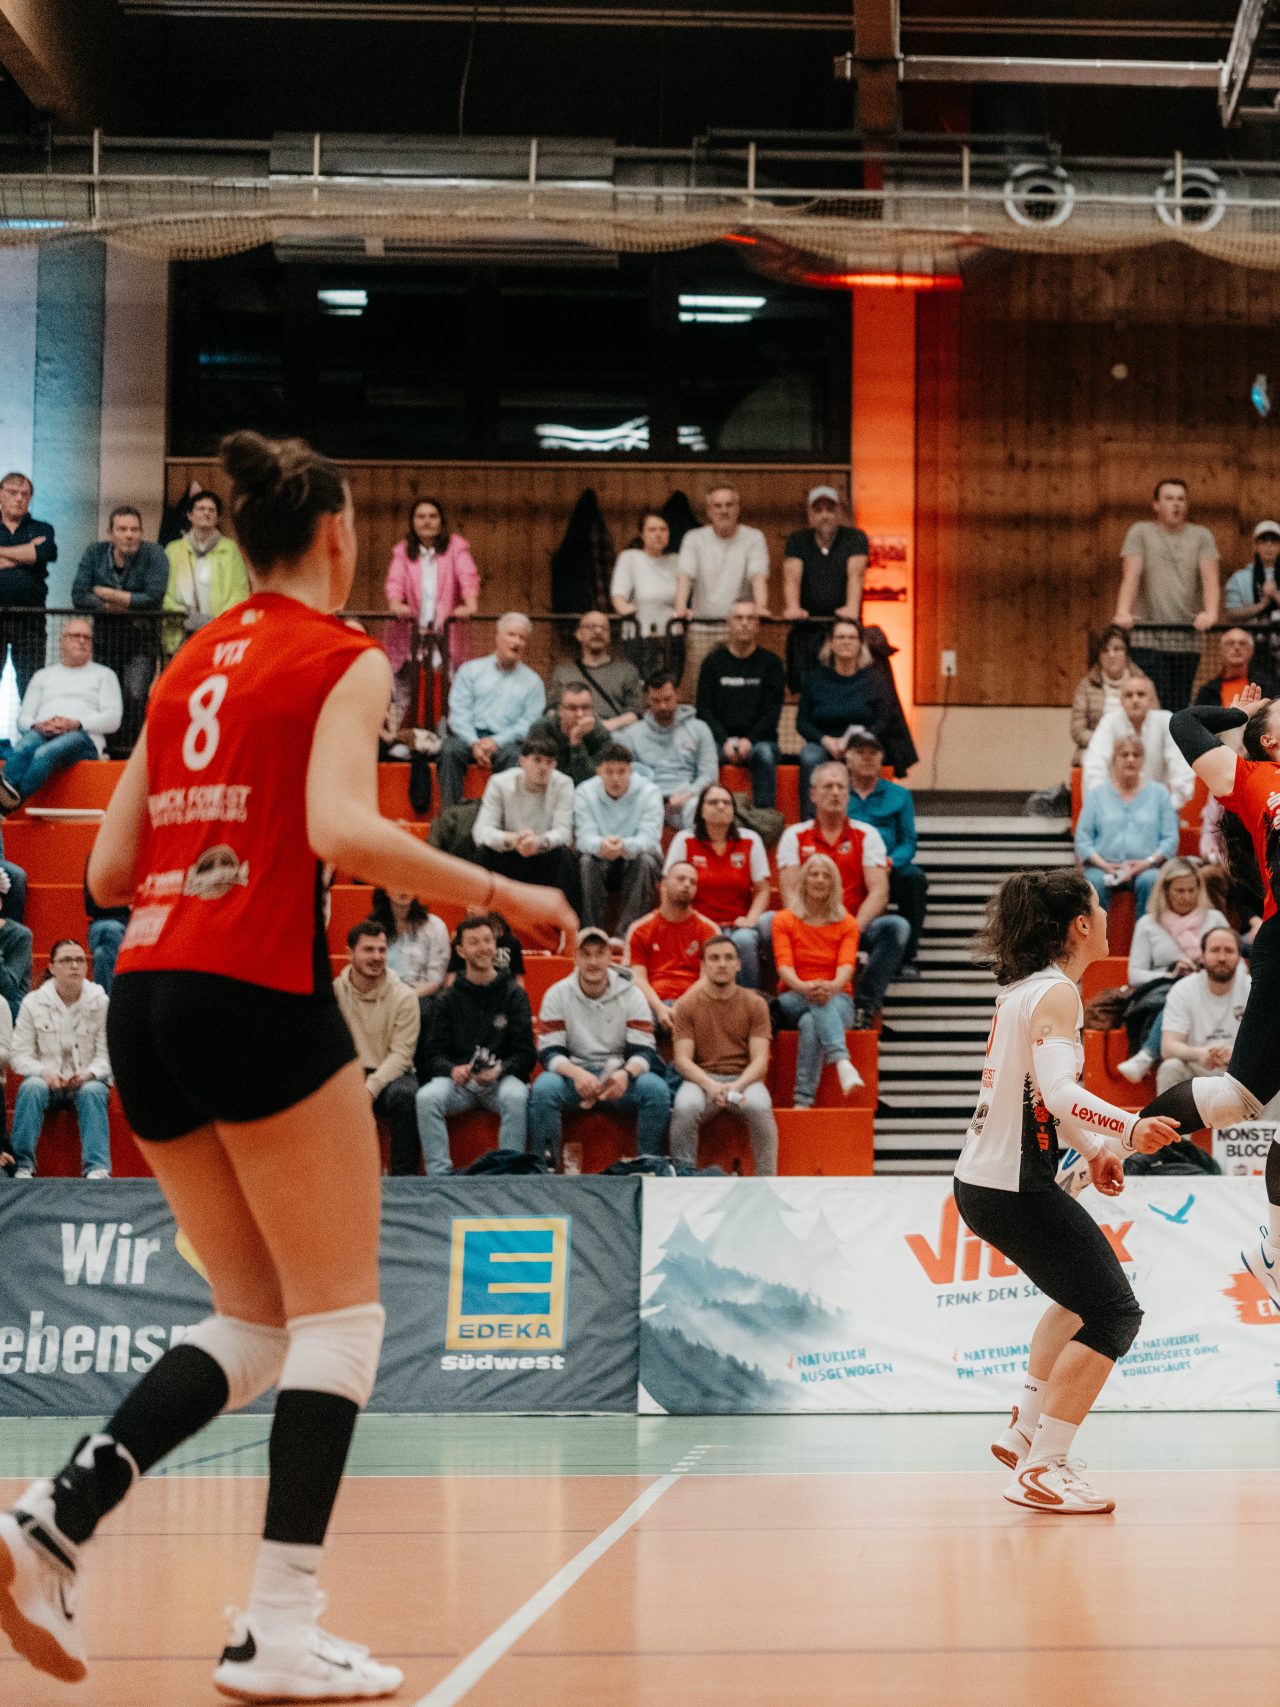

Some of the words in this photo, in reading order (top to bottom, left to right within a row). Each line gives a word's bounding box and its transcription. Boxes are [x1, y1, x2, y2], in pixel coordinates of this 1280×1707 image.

[182, 674, 229, 772] 8
[1071, 1103, 1125, 1134] Lexwar
[1226, 1144, 1268, 1158] BLOC
[61, 1222, 160, 1286] Wir
[935, 1291, 982, 1309] TRINK
[988, 1286, 1018, 1302] DEN
[458, 1322, 552, 1340] EDEKA
[440, 1354, 566, 1372] Südwest
[800, 1362, 894, 1384] AUSGEWOGEN
